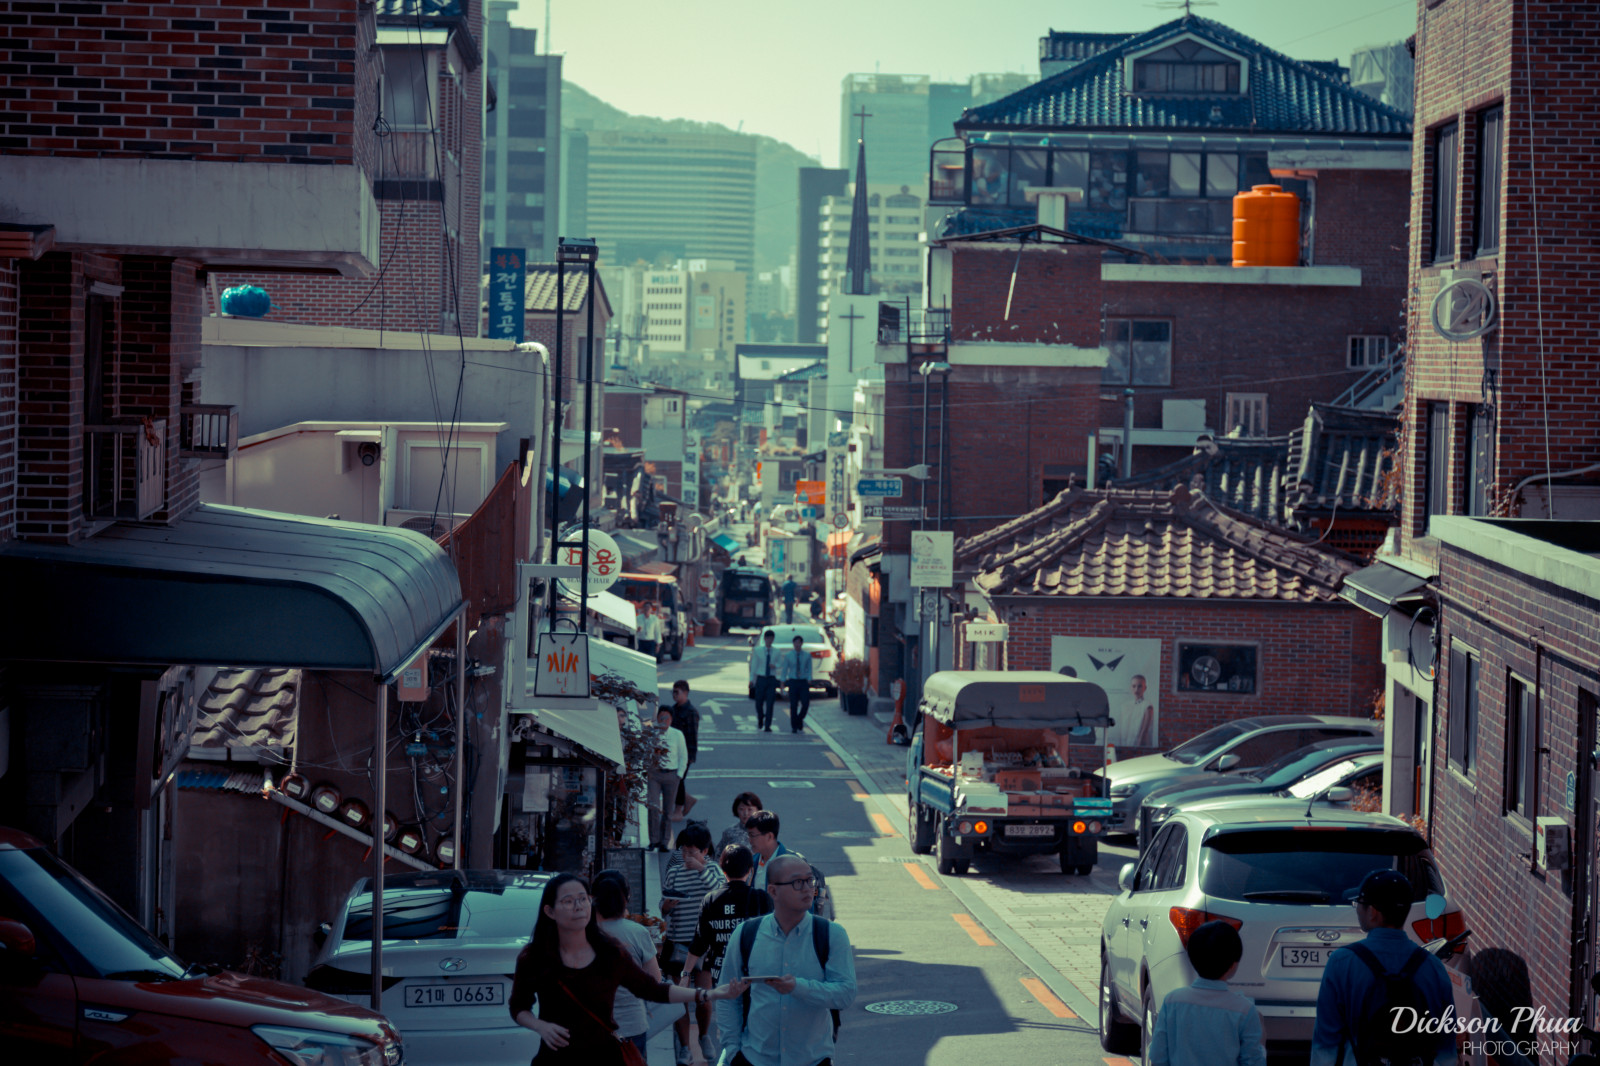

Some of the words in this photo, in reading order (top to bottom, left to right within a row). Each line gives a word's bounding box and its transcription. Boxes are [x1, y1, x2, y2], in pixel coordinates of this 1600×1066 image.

[724, 904, 736, 915] BE
[1291, 950, 1320, 964] 39더
[414, 988, 444, 1004] 21마
[453, 986, 494, 1003] 0663
